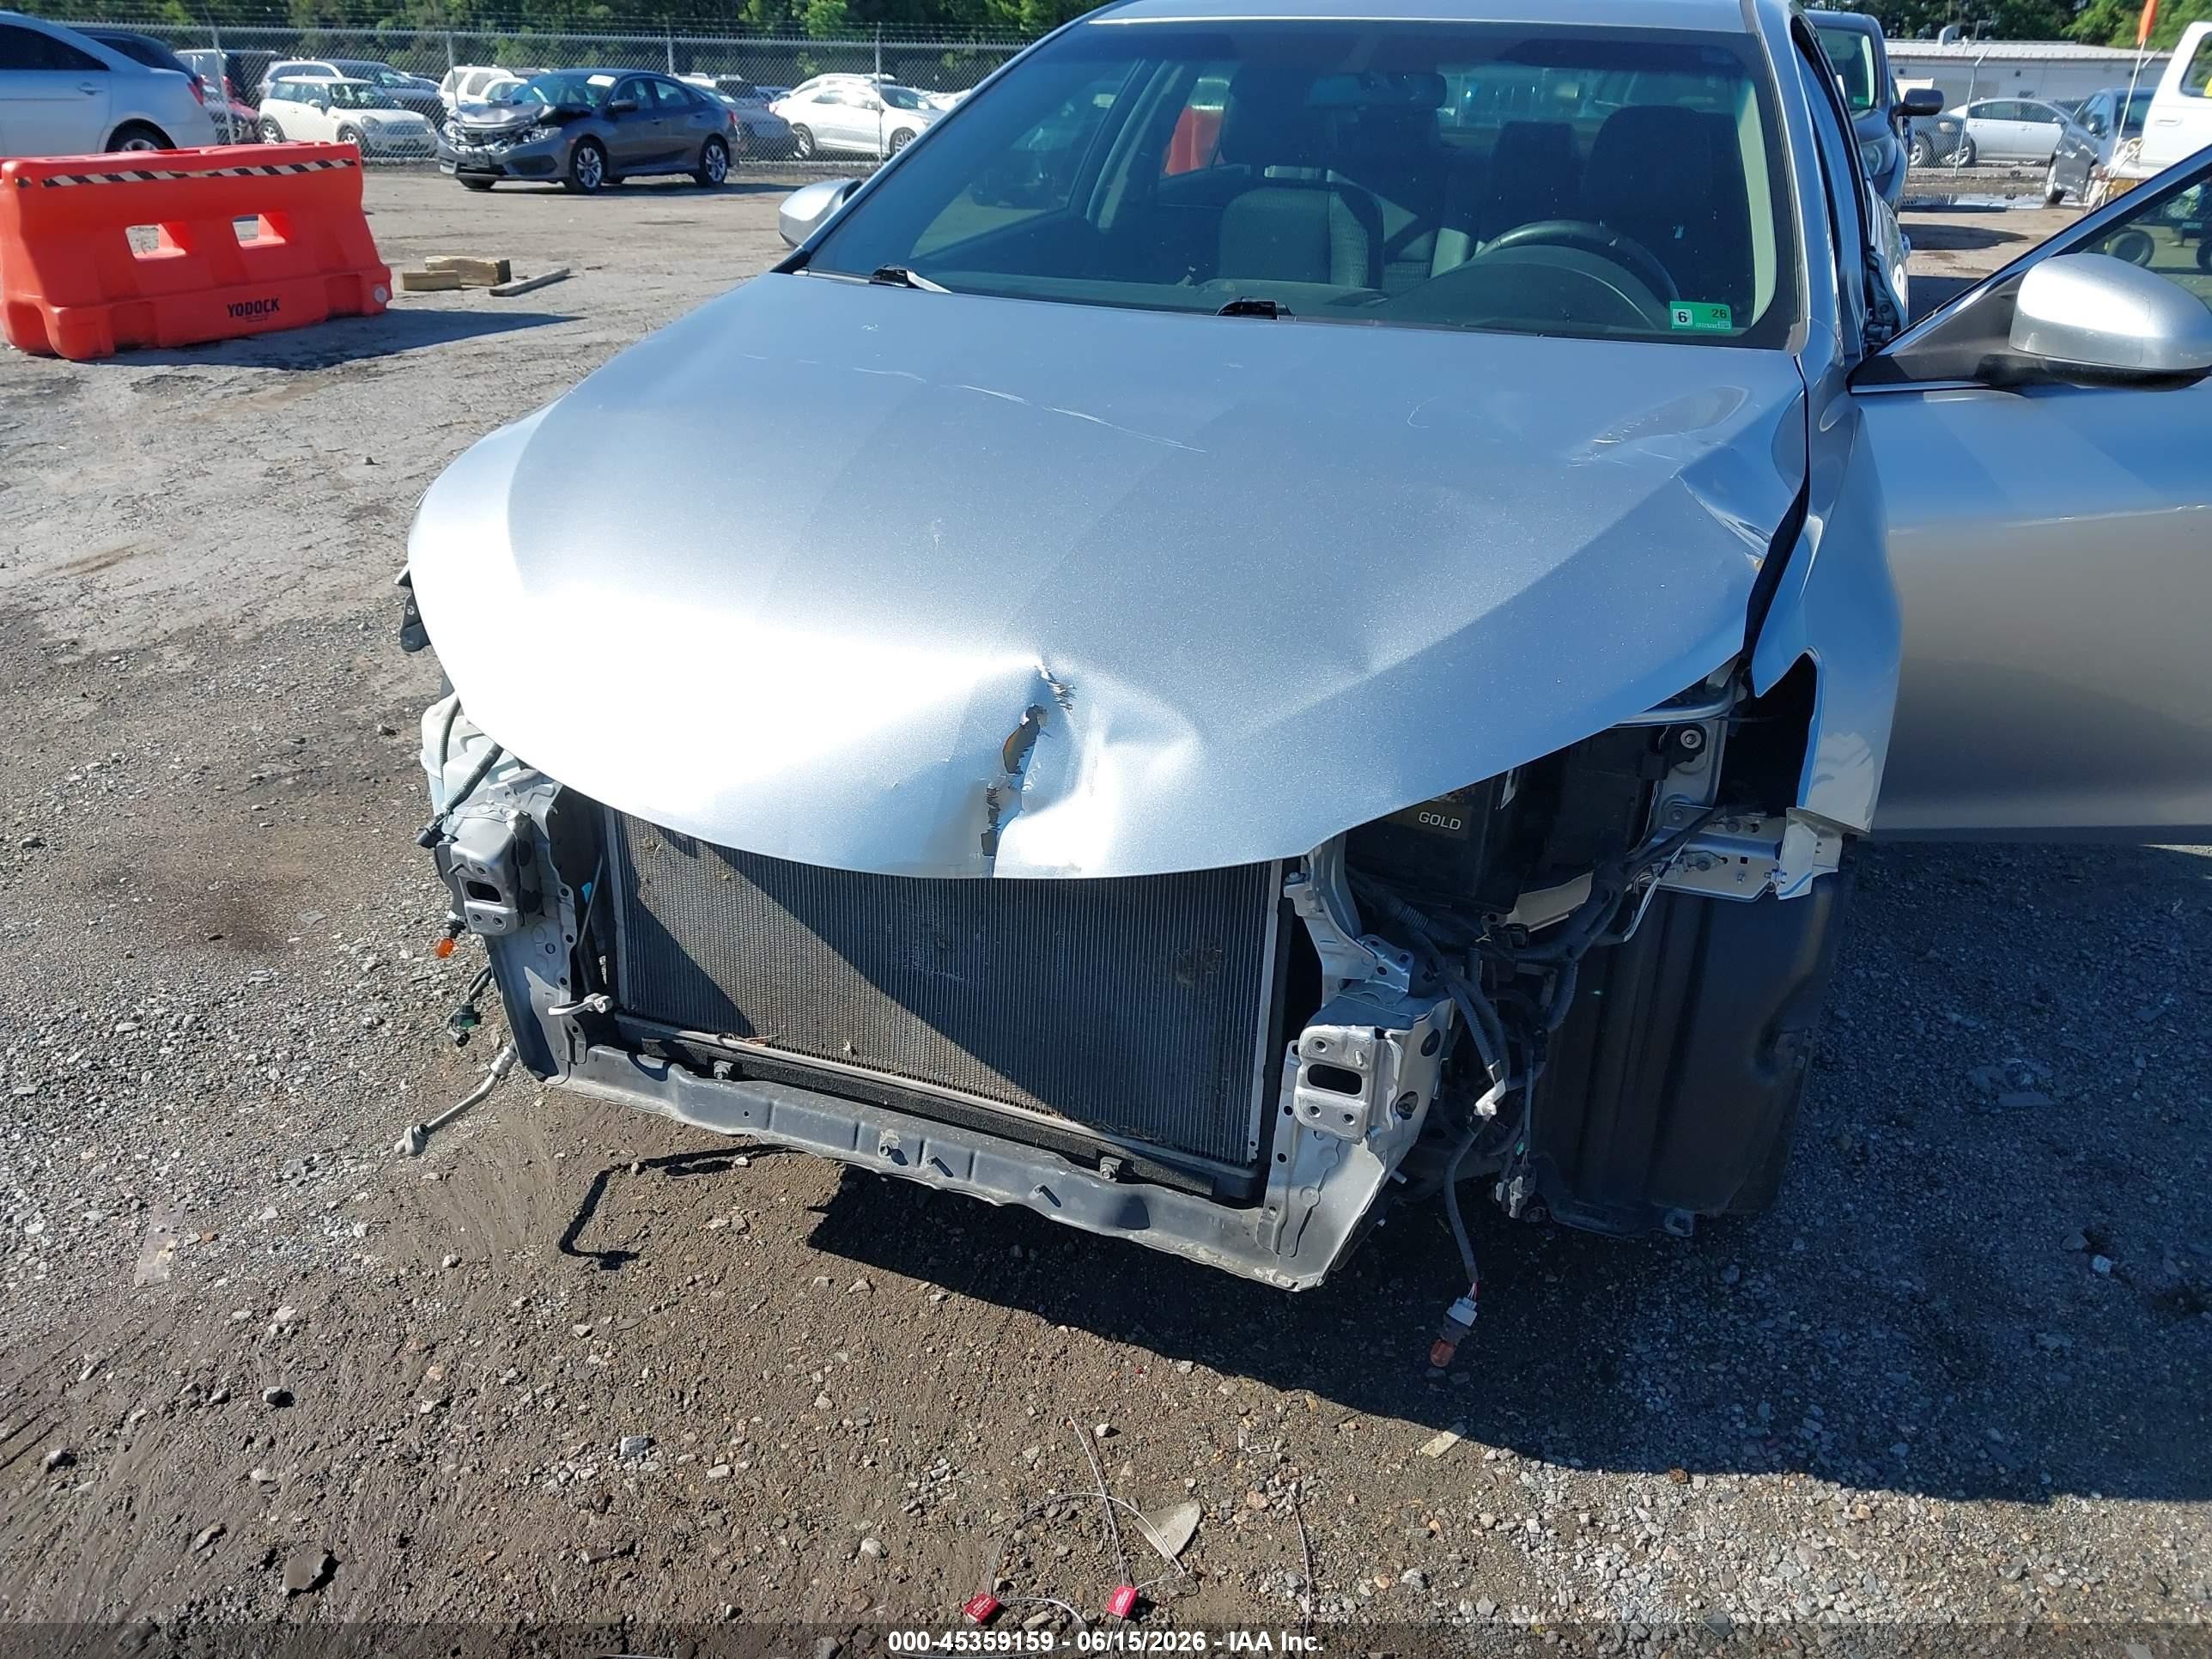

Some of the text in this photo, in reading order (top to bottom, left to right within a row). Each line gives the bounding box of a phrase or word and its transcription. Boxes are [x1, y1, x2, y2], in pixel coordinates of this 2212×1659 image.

[227, 297, 280, 318] YODOCK
[1711, 308, 1727, 319] 26
[1678, 311, 1687, 323] 6
[1419, 811, 1462, 830] GOLD
